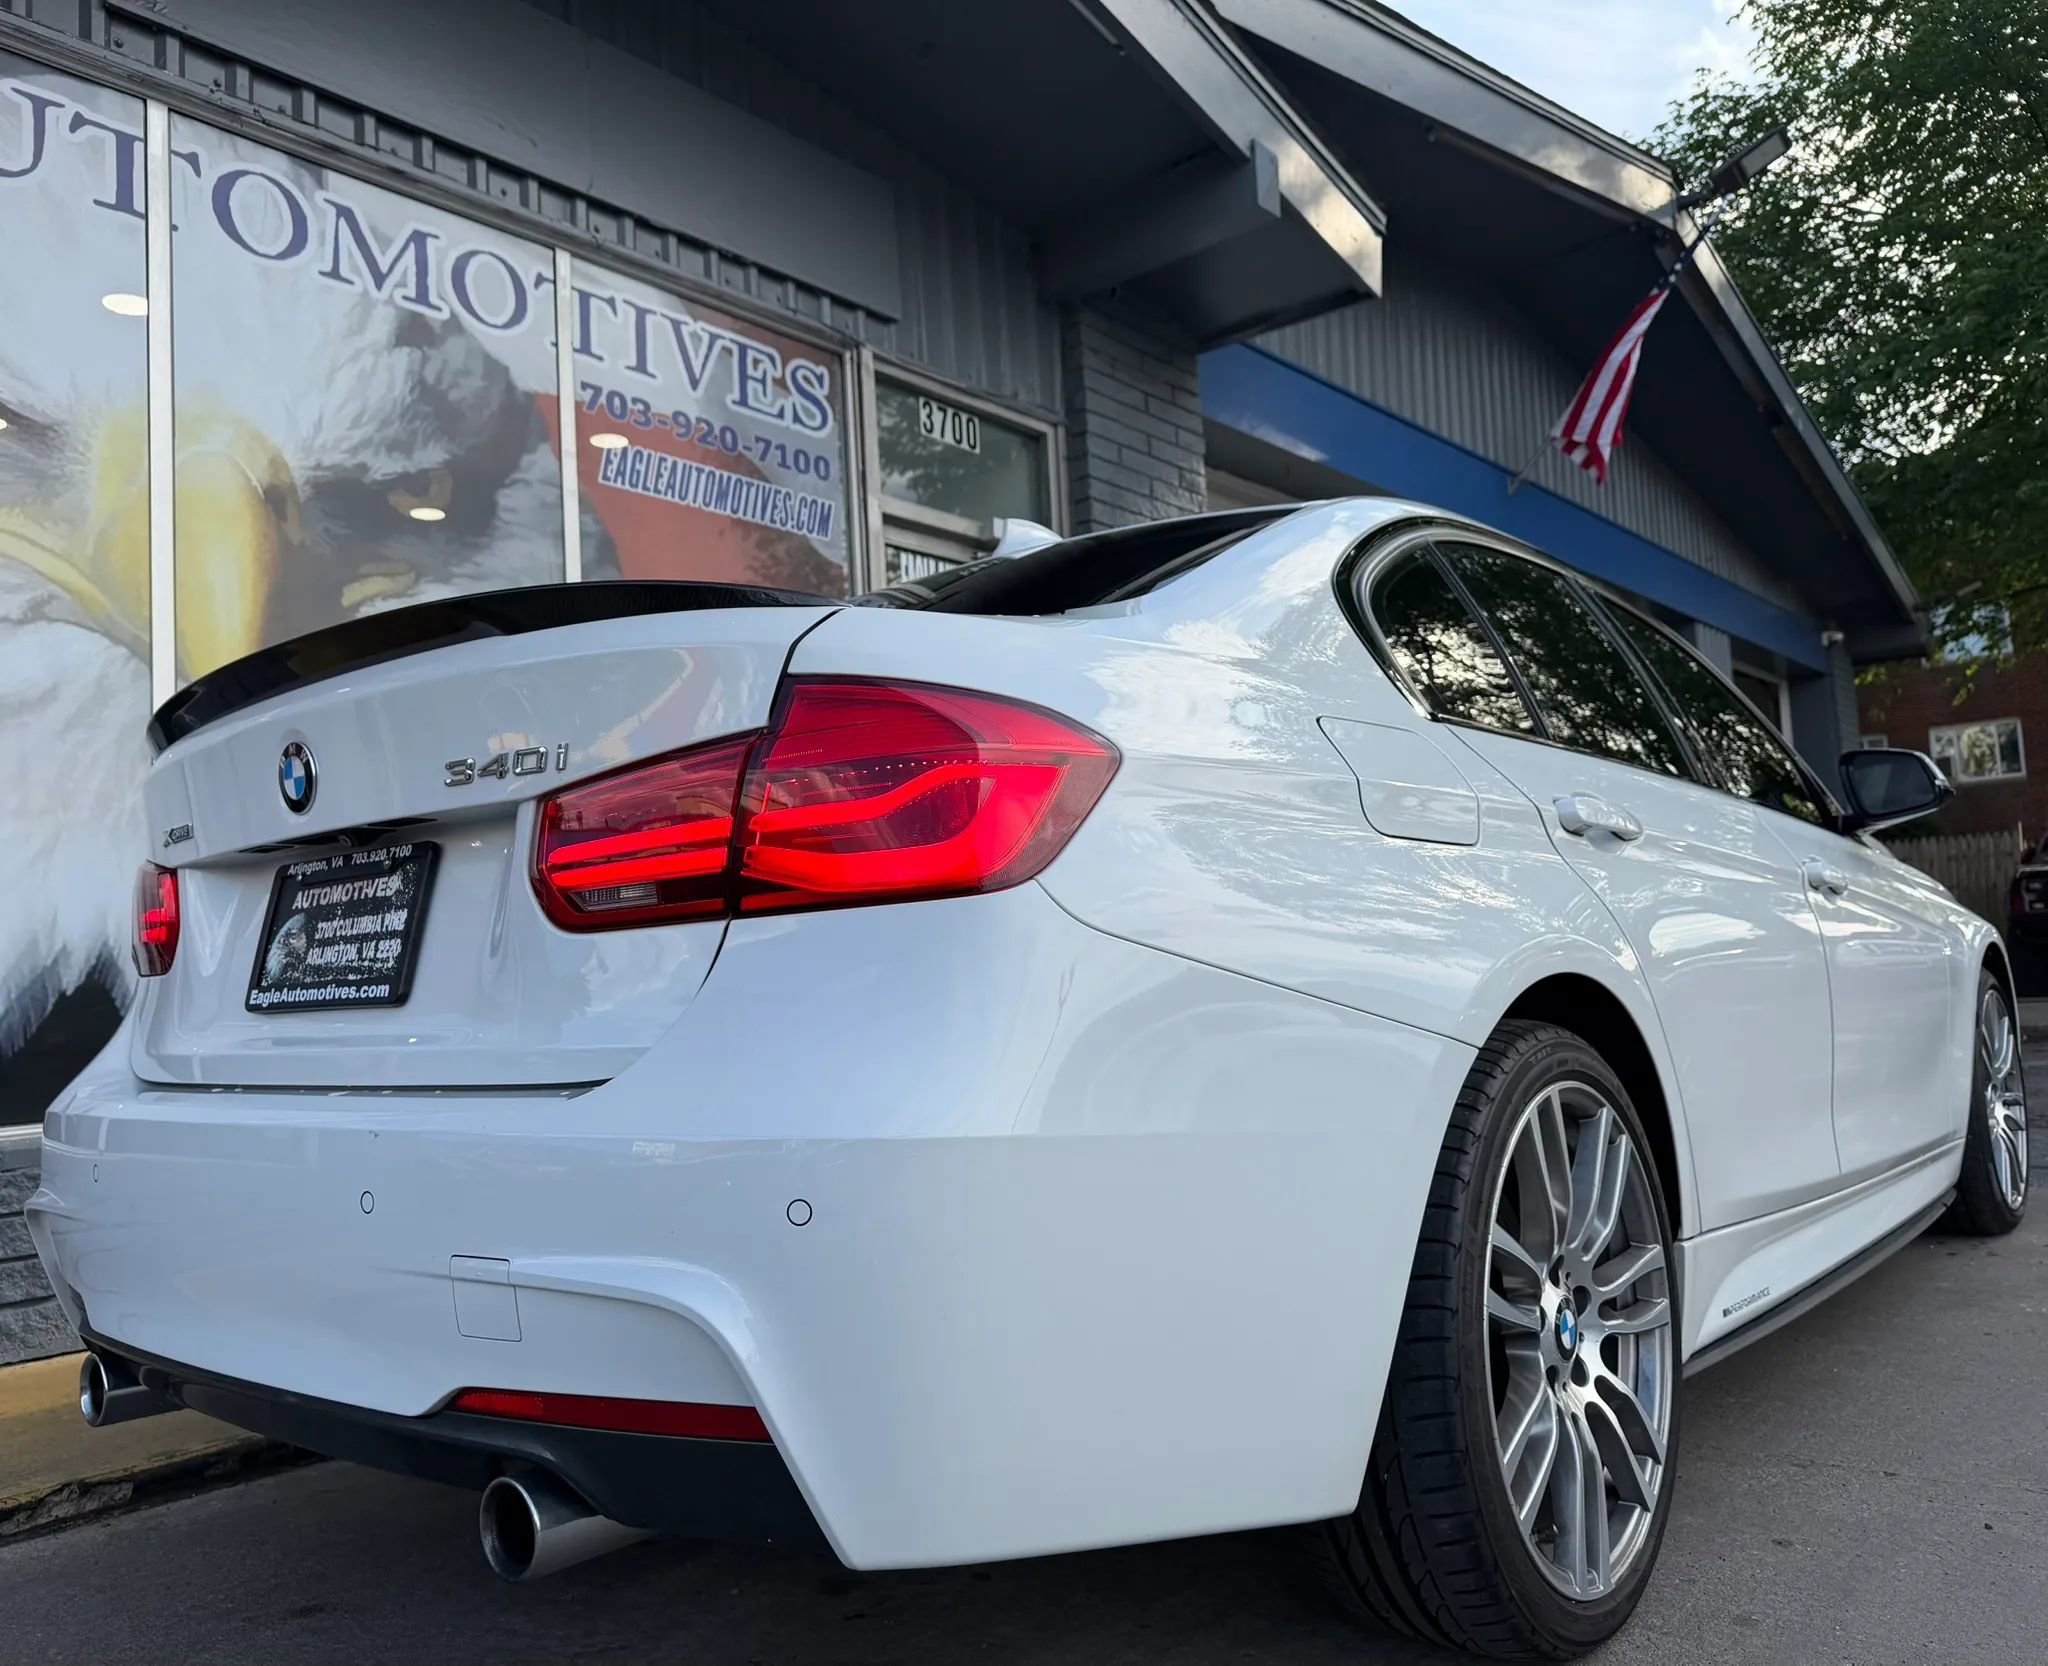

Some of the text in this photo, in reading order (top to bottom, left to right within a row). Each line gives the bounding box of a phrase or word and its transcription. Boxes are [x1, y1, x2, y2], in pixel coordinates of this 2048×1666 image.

[579, 381, 831, 481] 703-920-7100
[921, 401, 978, 450] 3700
[602, 449, 833, 538] EAGLEAUTOMOTIVES.COM
[288, 845, 412, 876] Arlington, VA 703.920.7100
[362, 940, 376, 959] VA
[250, 984, 390, 1007] EagleAutomotives.com
